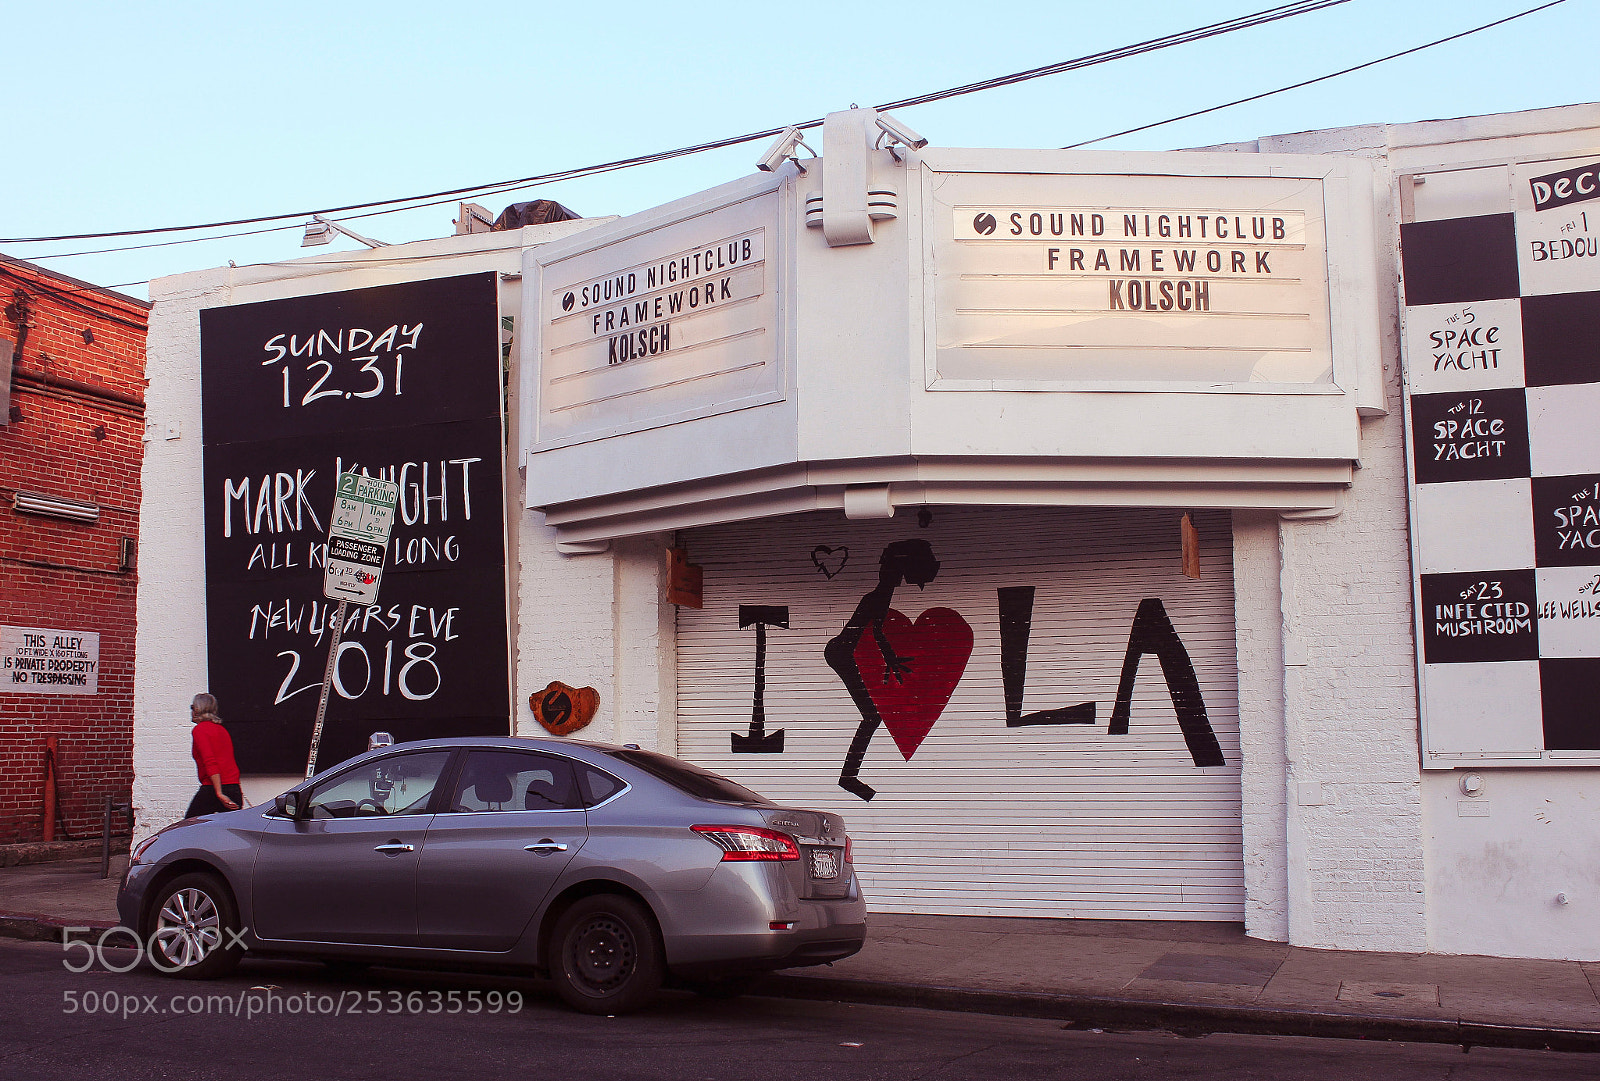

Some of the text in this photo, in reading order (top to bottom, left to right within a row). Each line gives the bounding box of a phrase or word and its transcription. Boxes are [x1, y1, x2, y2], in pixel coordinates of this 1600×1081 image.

[1010, 212, 1286, 240] SOUND NIGHTCLUB
[1560, 211, 1588, 235] FRI 1
[1530, 237, 1598, 261] BEDOU
[1048, 248, 1272, 273] FRAMEWORK
[581, 238, 752, 307] SOUND NIGHTCLUB
[592, 277, 732, 335] FRAMEWORK
[1109, 280, 1210, 312] KOLSCH
[1445, 306, 1476, 325] TUE 5
[262, 322, 424, 366] SUNDAY
[608, 322, 671, 365] KOLSCH
[1432, 349, 1502, 371] YACHT
[282, 354, 403, 408] 12.31
[1447, 398, 1485, 415] TUE 12
[1433, 440, 1506, 460] YACHT
[343, 476, 388, 492] 2 HOUR
[357, 484, 395, 503] PARKING
[1571, 487, 1591, 502] TUE
[224, 457, 482, 537] MARK GHT
[1553, 505, 1600, 529] SPA
[247, 542, 299, 570] ALL
[331, 547, 359, 560] LOADING
[361, 553, 382, 564] ZONE
[336, 540, 378, 555] PASSENGER
[395, 535, 460, 566] LONG
[1460, 581, 1504, 600] SAT 23
[1578, 580, 1594, 594] SUN
[1435, 602, 1531, 620] INFECTED
[1538, 600, 1557, 620] LEE
[249, 598, 460, 647] NEW YEARS EVE
[1436, 618, 1532, 637] MUSHROOM
[24, 634, 83, 650] THIS ALLEY
[33, 648, 48, 657] WIDE
[74, 651, 88, 659] LONG
[4, 657, 96, 673] IS PRIVATE PROPERTY
[274, 640, 442, 706] 2018
[12, 671, 87, 686] NO TRESPASSING
